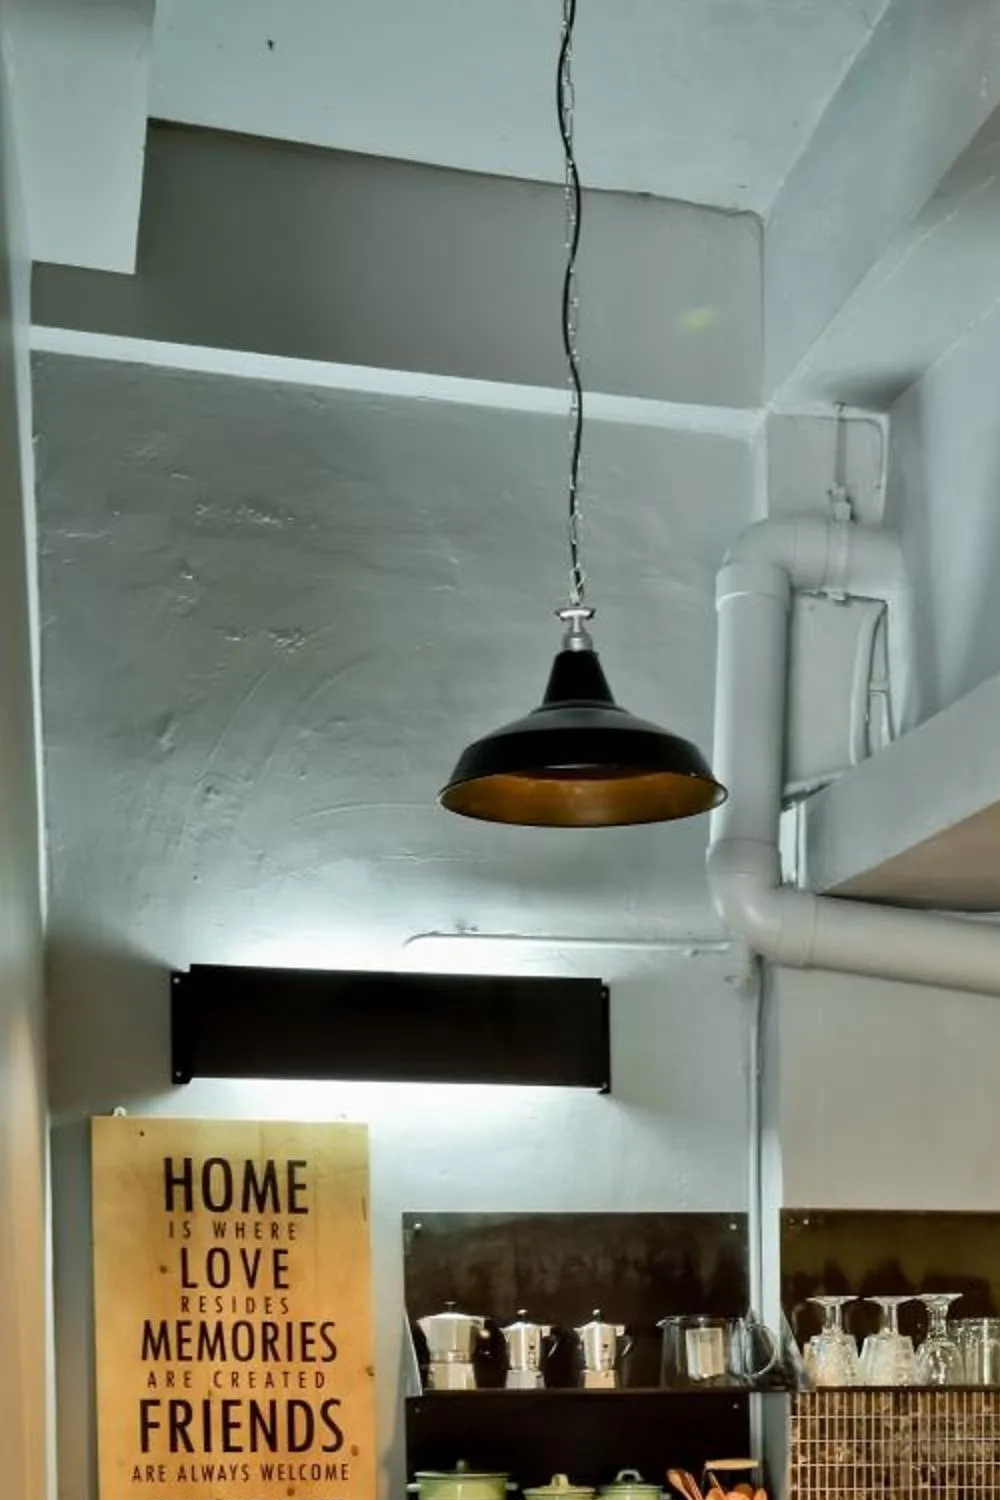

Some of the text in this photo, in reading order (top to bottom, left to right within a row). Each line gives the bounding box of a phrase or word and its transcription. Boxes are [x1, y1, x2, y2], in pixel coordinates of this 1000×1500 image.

[164, 1157, 308, 1214] HOME
[169, 1220, 297, 1241] IS WHERE
[180, 1247, 290, 1289] LOVE
[181, 1295, 289, 1315] RESIDES
[141, 1319, 338, 1363] MEMORIES
[147, 1370, 325, 1389] ARE CREATED
[139, 1398, 344, 1453] FRIENDS
[132, 1463, 349, 1482] ARE ALWAYS WELCOME
